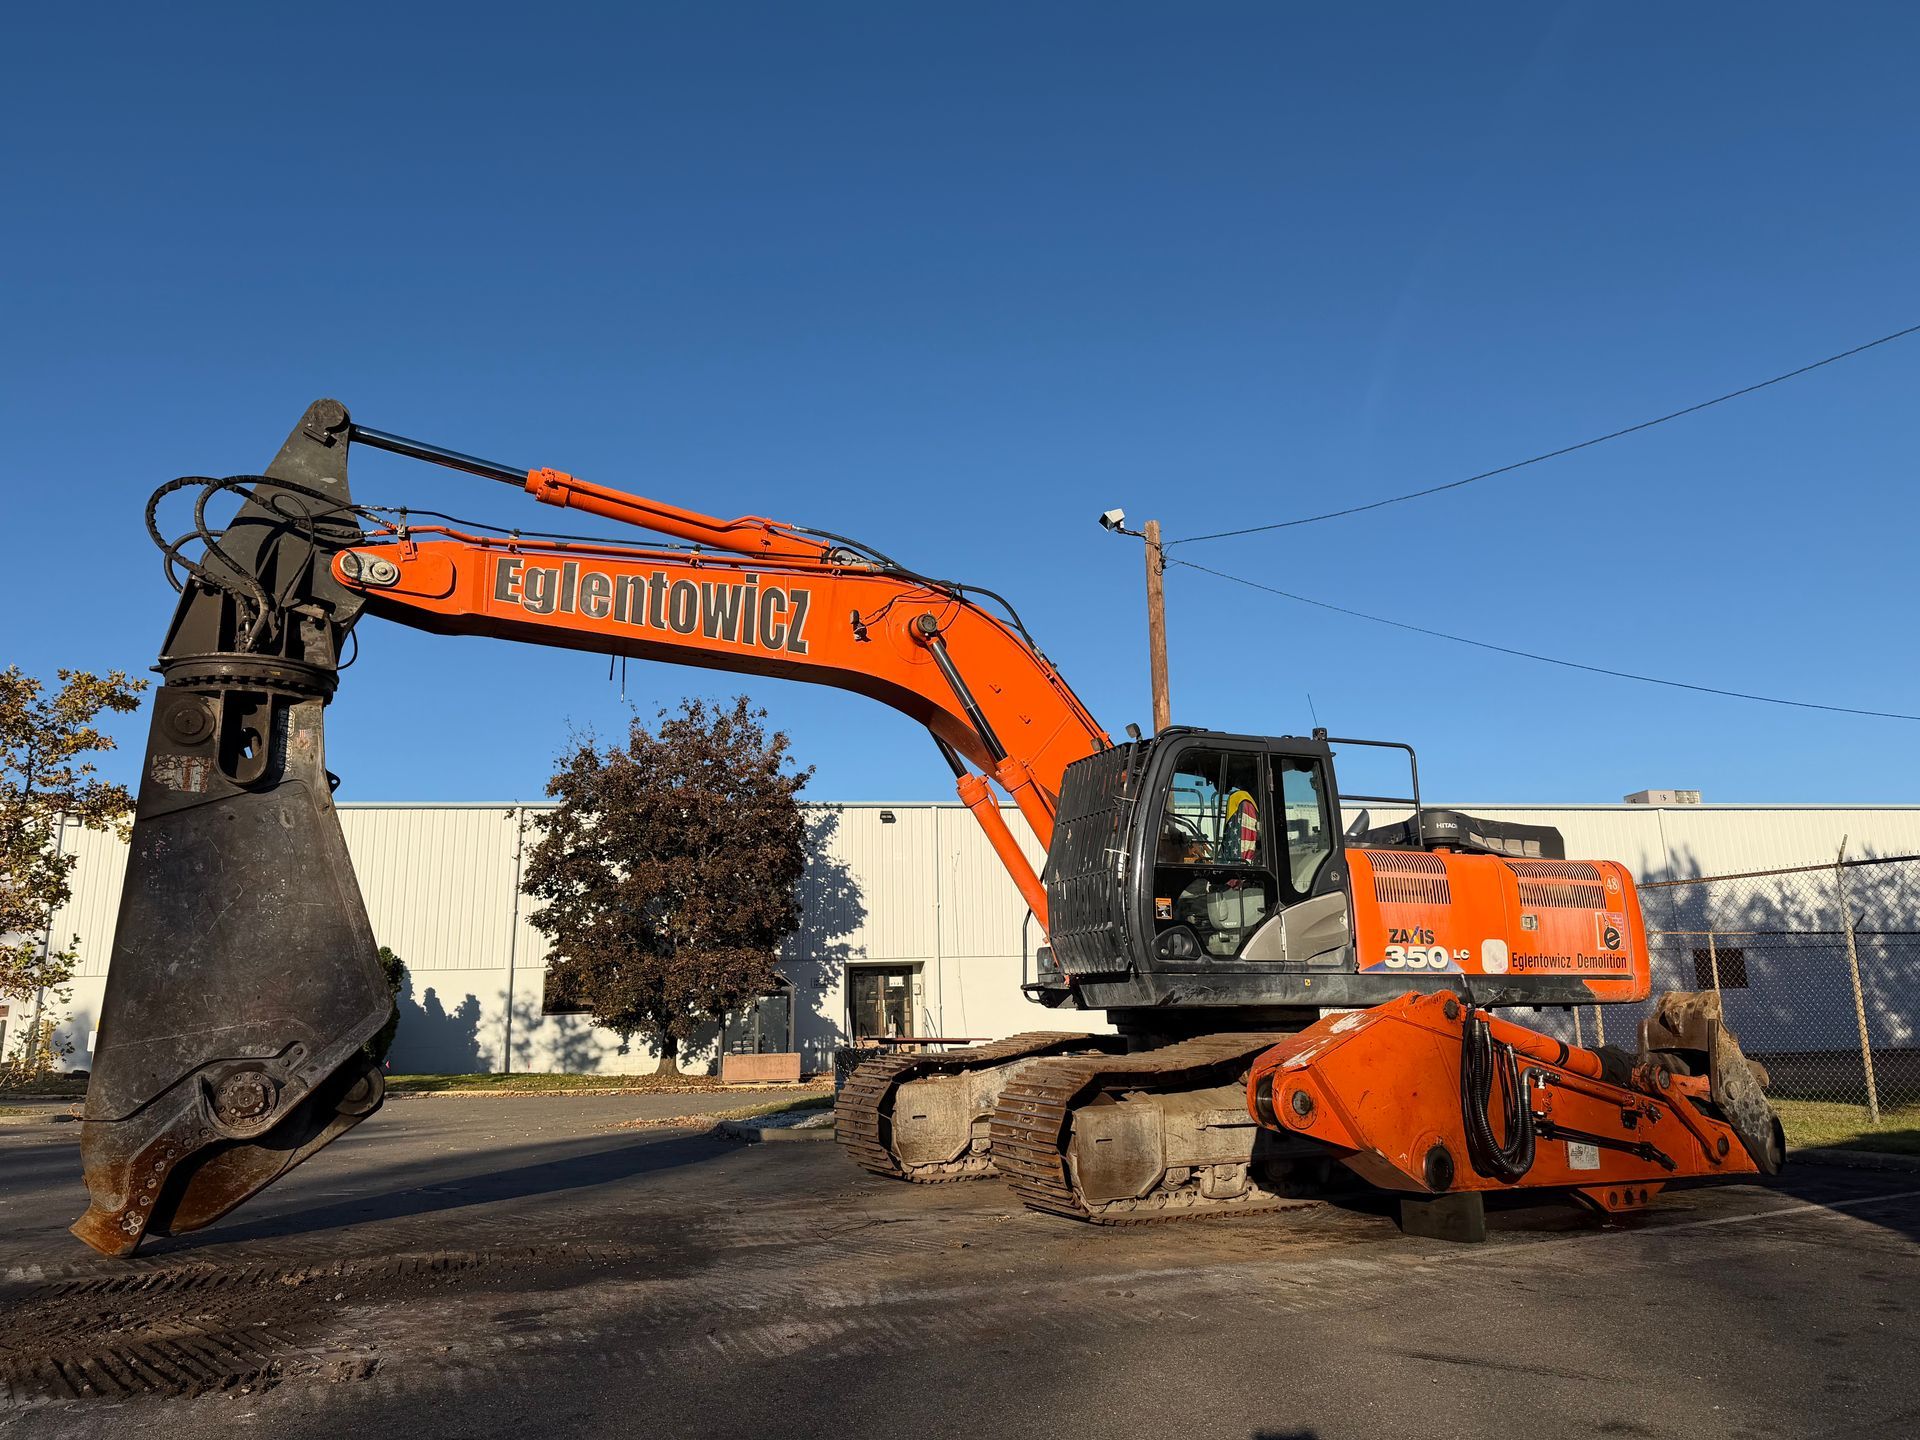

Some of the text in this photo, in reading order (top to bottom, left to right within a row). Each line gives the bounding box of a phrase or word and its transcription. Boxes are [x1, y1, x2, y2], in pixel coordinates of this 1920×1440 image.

[494, 557, 811, 653] Eglentowicz
[1606, 877, 1618, 890] 48
[1385, 945, 1470, 969] 350 LC
[1512, 952, 1627, 971] Eglentowicz Demolition
